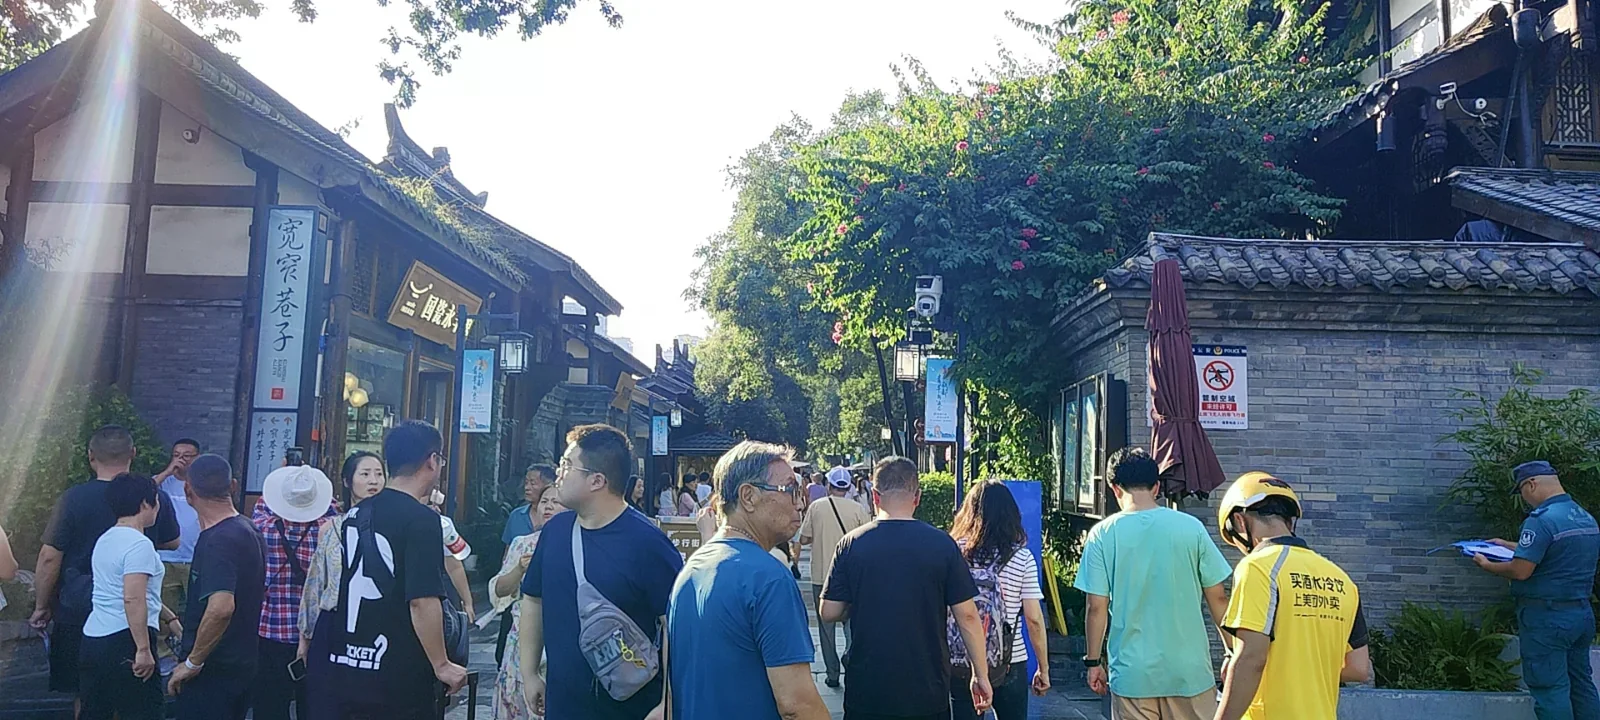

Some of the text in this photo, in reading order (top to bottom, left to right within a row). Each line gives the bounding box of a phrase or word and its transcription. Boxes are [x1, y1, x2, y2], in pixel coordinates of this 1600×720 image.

[271, 218, 303, 351] 宽窄巷子
[256, 427, 265, 461] 井巷子
[1290, 573, 1345, 594] 买酒水冷饮
